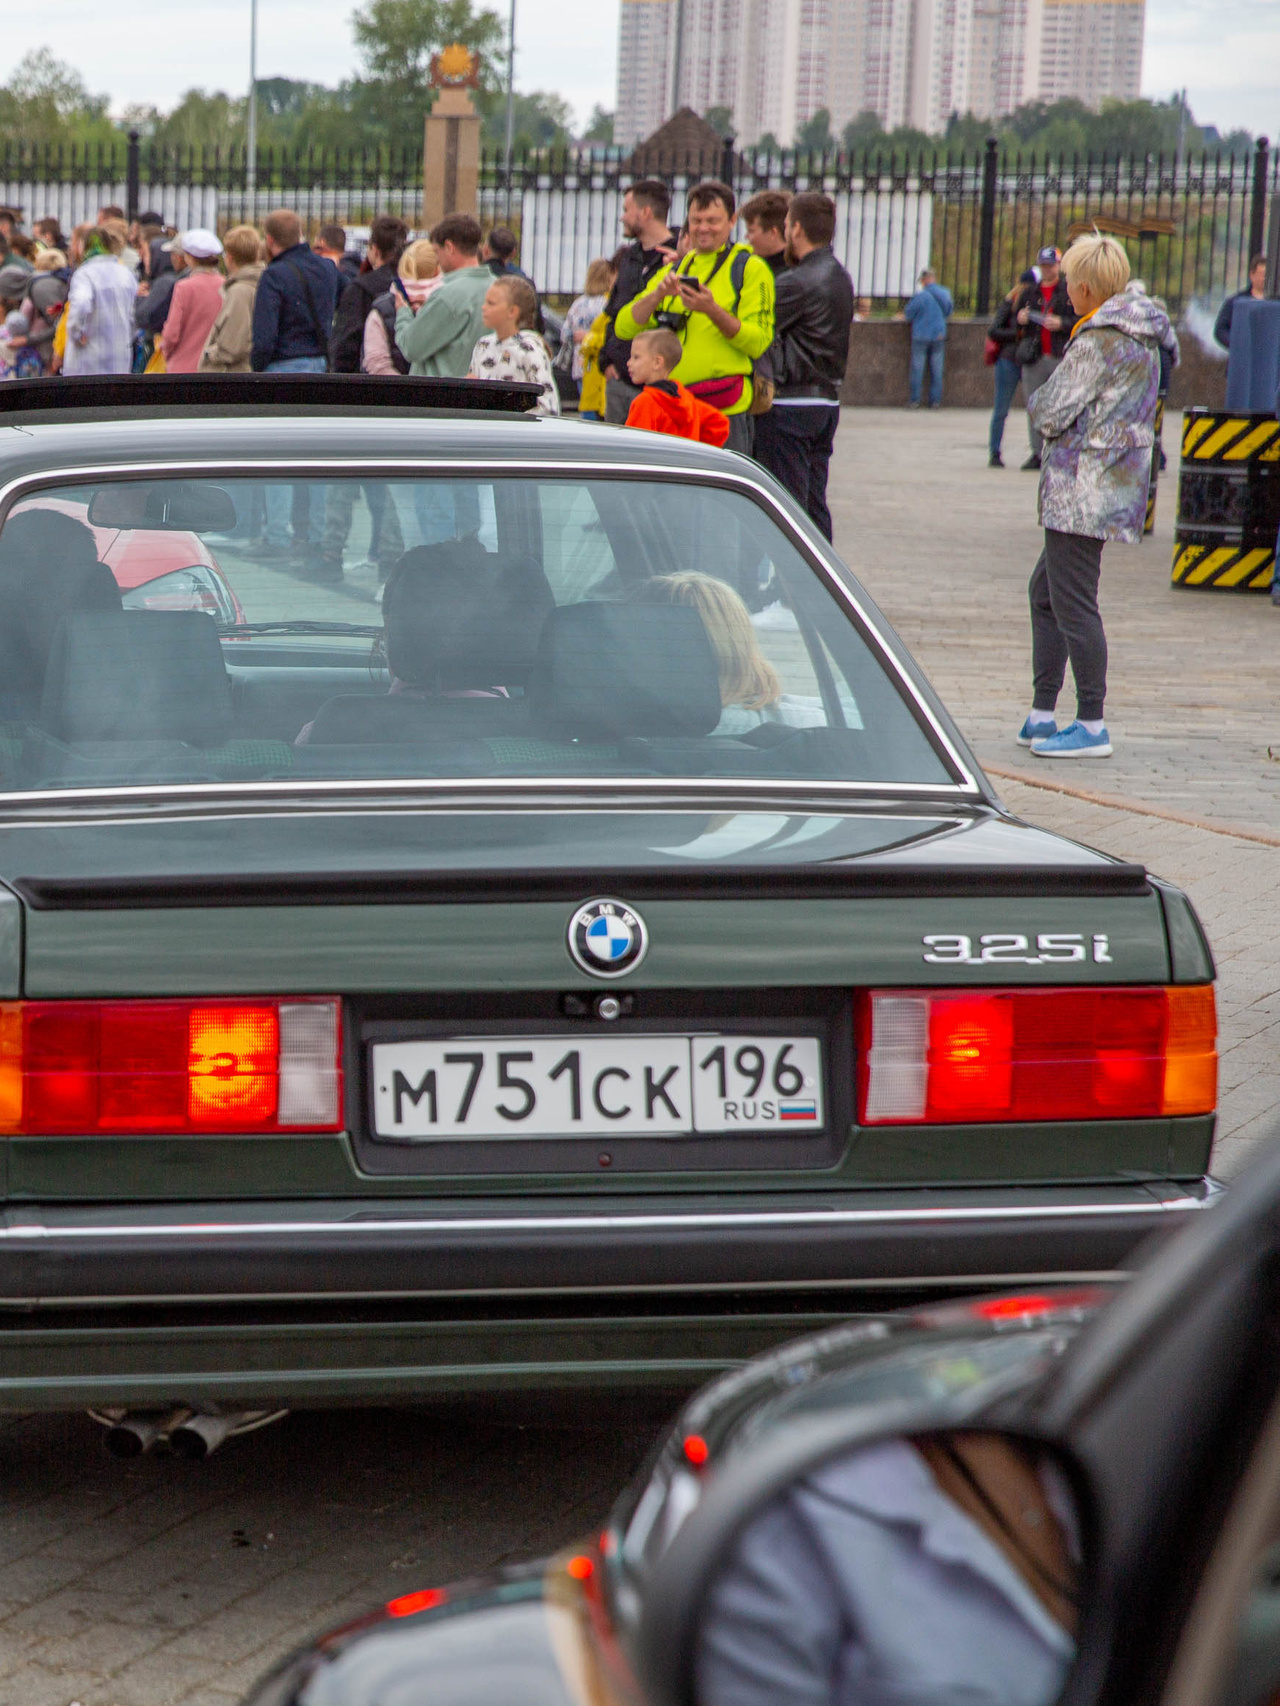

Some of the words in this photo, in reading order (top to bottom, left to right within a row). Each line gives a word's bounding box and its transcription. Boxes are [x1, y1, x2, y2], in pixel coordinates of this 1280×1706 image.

[577, 903, 638, 928] BMW
[922, 932, 1113, 965] 325i
[699, 1043, 805, 1099] 196
[723, 1100, 776, 1122] RUS
